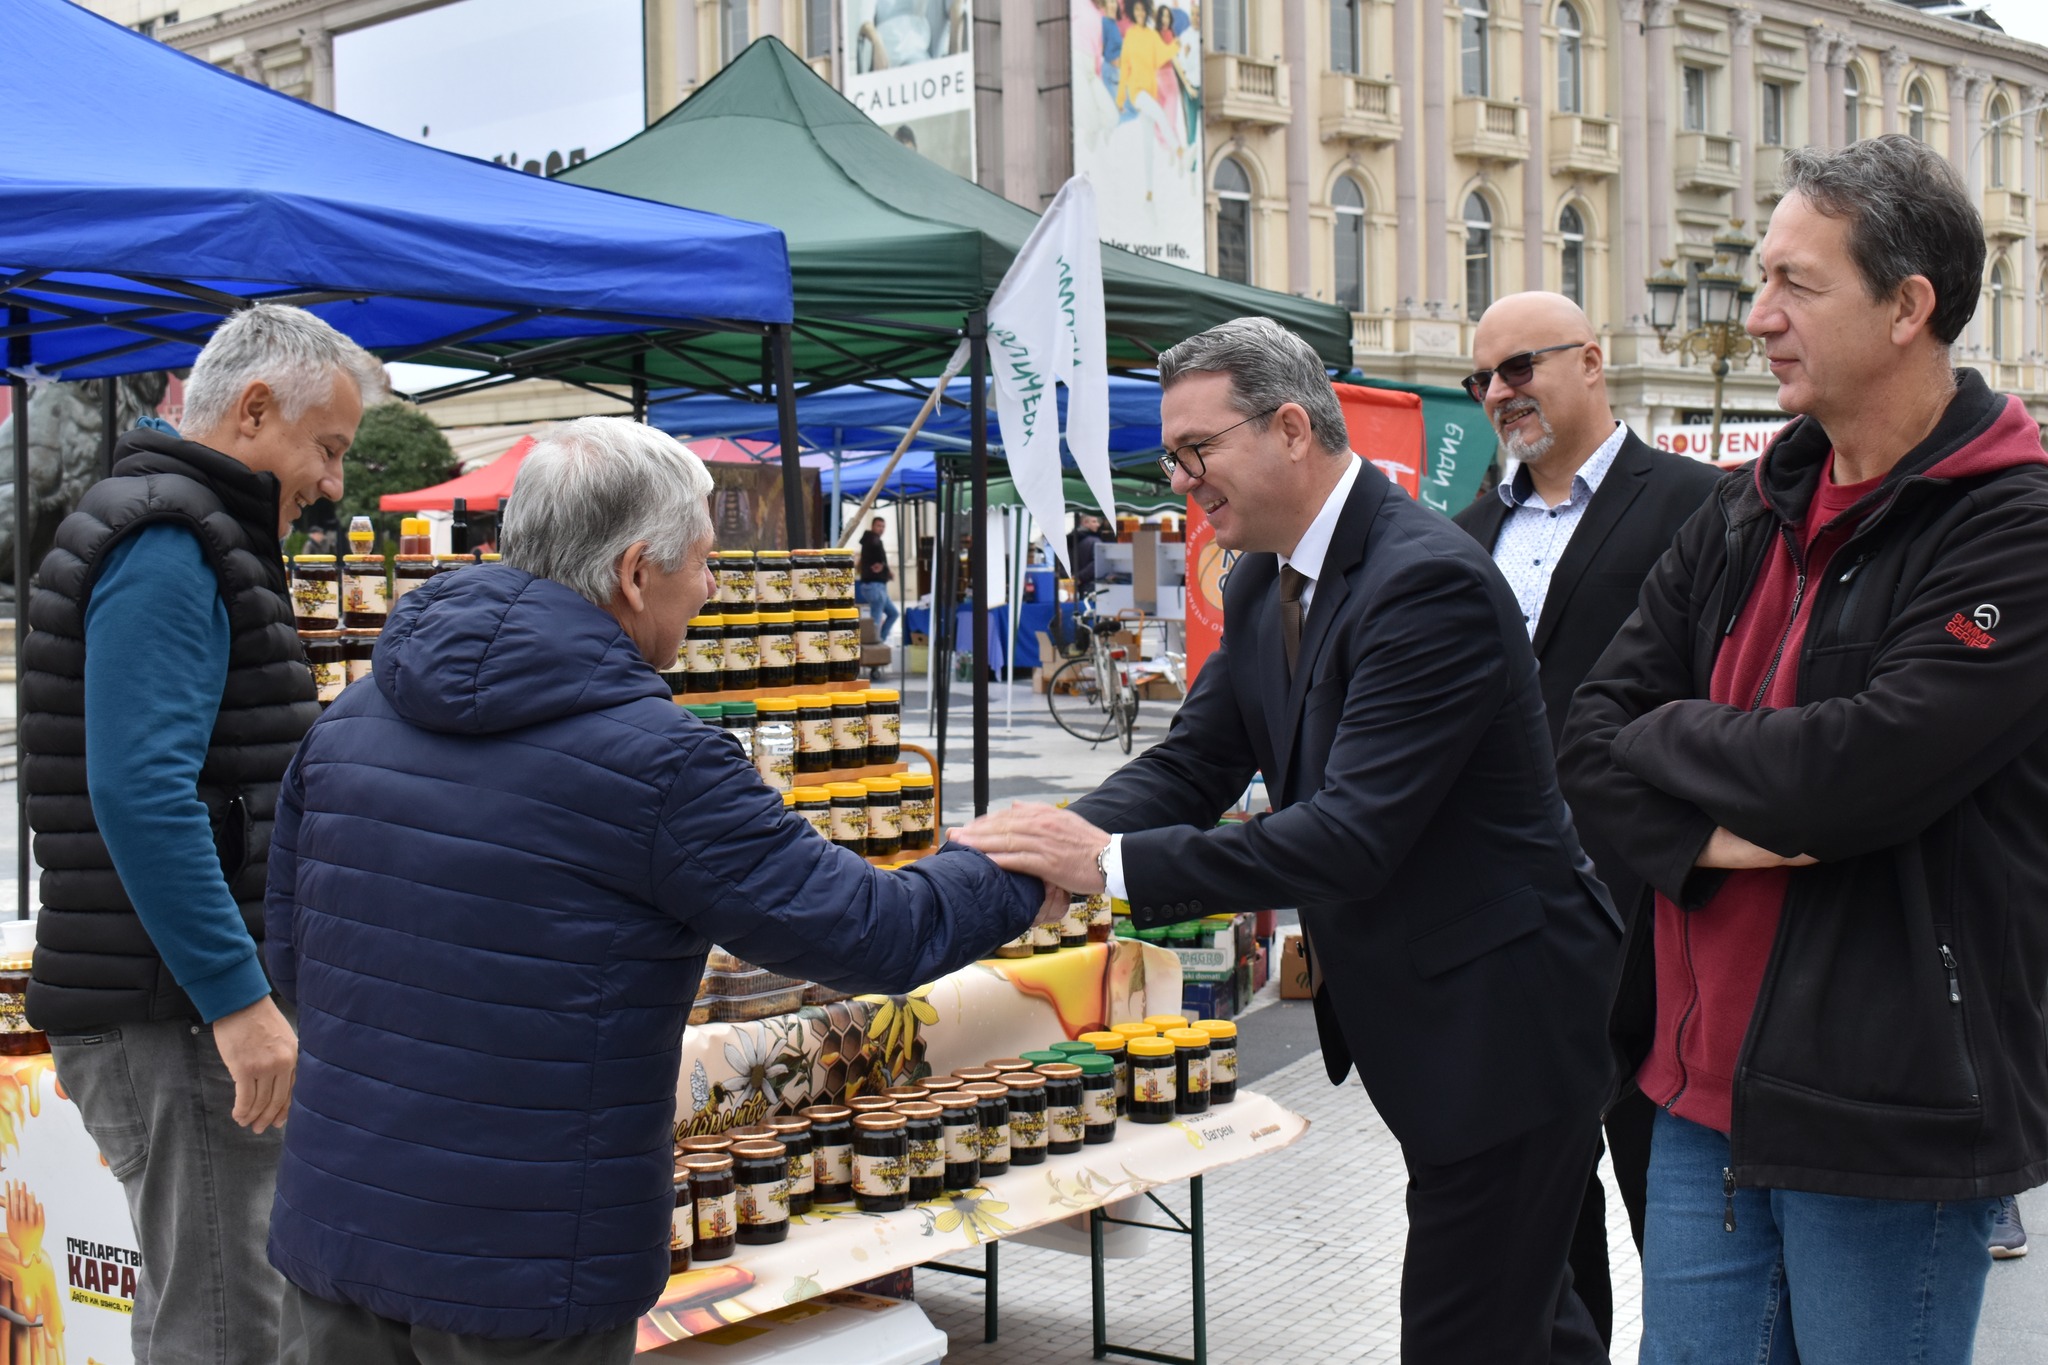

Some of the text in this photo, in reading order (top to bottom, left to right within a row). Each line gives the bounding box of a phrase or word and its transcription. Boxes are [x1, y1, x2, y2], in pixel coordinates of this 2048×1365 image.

[854, 71, 964, 112] CALLIOPE
[1133, 244, 1162, 258] your
[1166, 244, 1190, 258] life.
[1944, 621, 1990, 649] SERIES
[1952, 612, 1997, 646] SUMMIT
[1202, 1124, 1236, 1141] багрем
